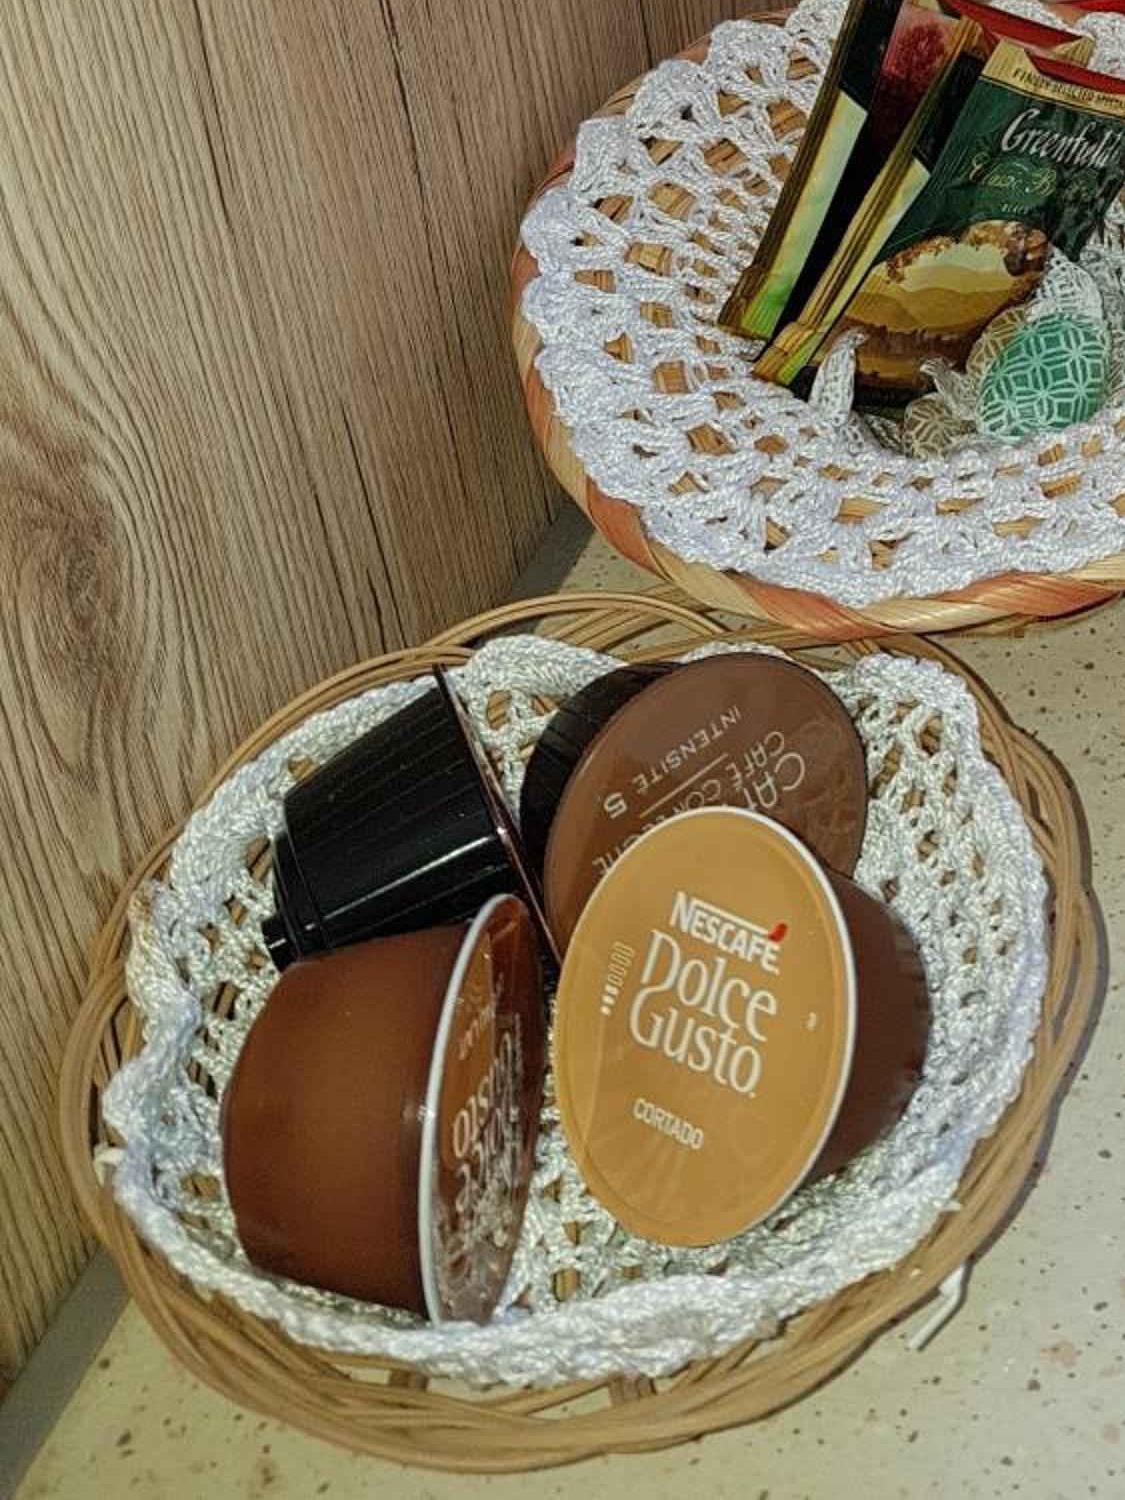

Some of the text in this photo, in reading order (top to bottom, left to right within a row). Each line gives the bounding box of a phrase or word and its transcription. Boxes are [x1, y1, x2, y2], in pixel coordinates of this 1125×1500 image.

[1001, 107, 1122, 169] Greenfield
[603, 792, 628, 819] 5
[640, 929, 778, 1042] Dolce
[629, 987, 762, 1093] Gusto
[633, 1098, 705, 1150] CORTADO
